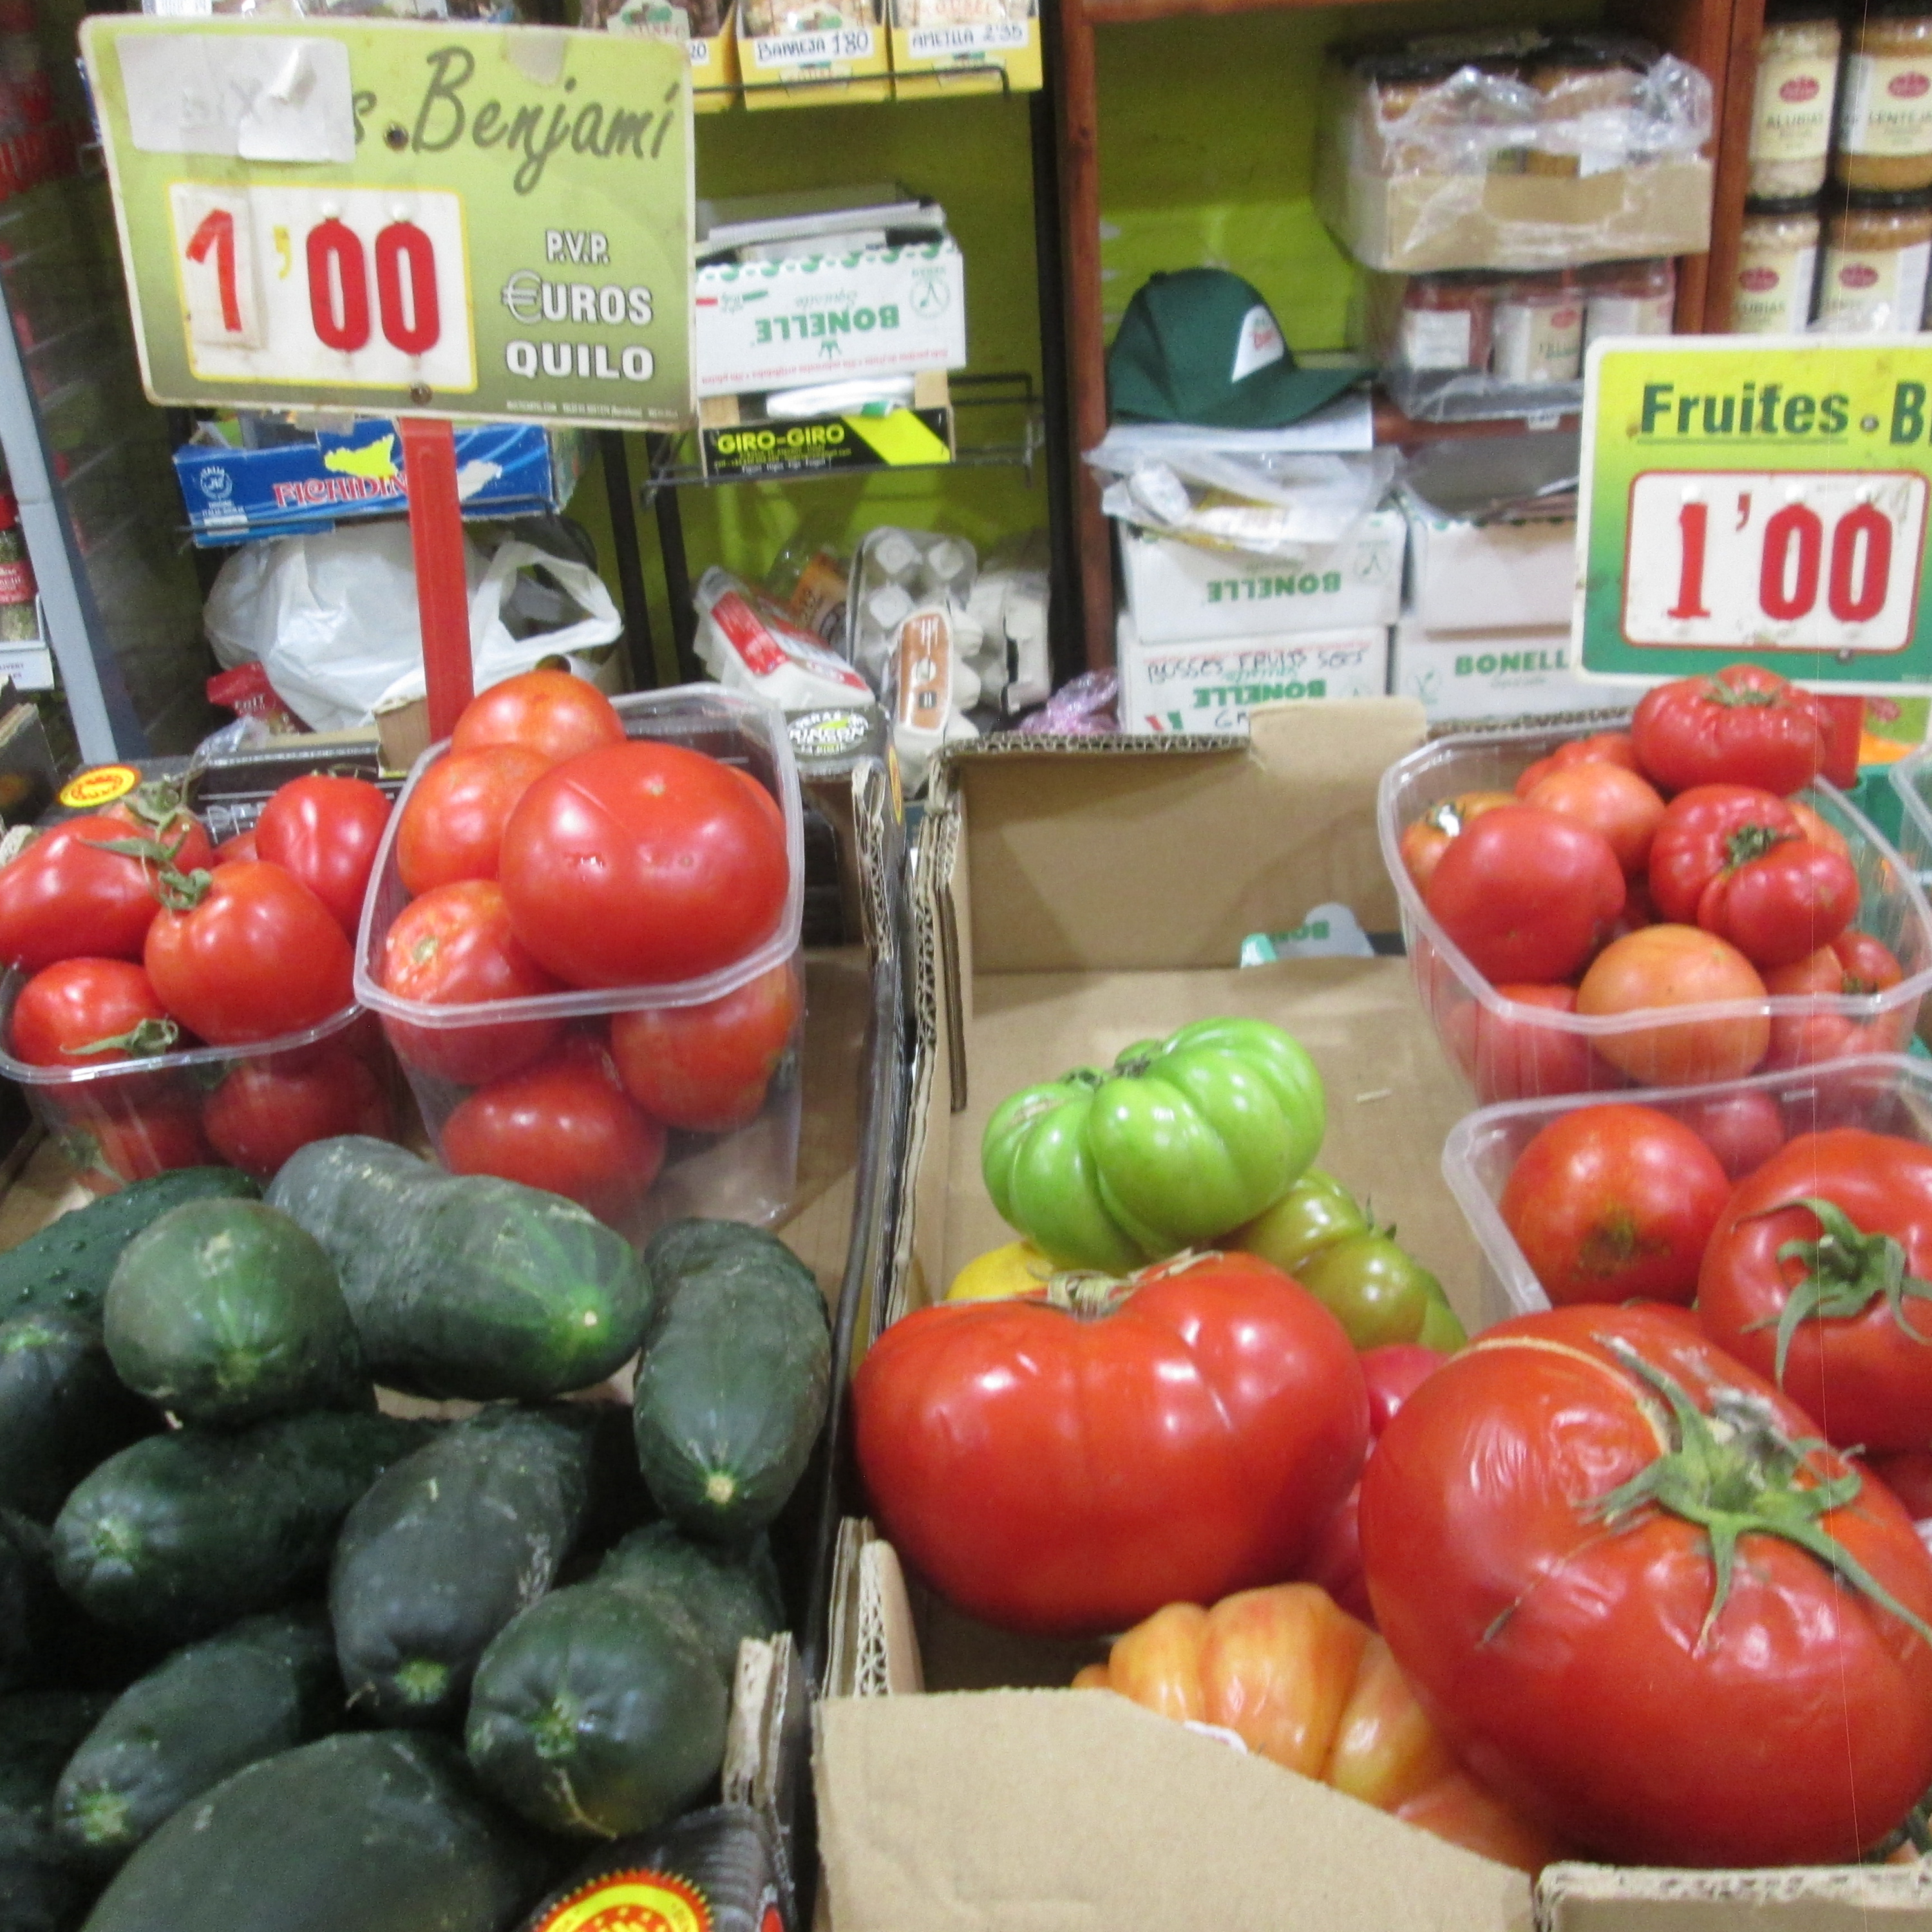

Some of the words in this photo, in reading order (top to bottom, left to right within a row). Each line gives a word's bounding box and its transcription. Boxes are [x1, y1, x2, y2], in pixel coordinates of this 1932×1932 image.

[545, 229, 611, 265] P.V.P.
[755, 303, 900, 344] BONELLE
[505, 339, 655, 382] QUILO
[1640, 381, 1850, 436] Fruites
[717, 424, 846, 455] GIRO-GIRO
[1667, 491, 1893, 623] 1'00
[1207, 572, 1342, 603] BONELLE
[1455, 650, 1569, 676] BONELL
[1193, 679, 1327, 709] BONELLE
